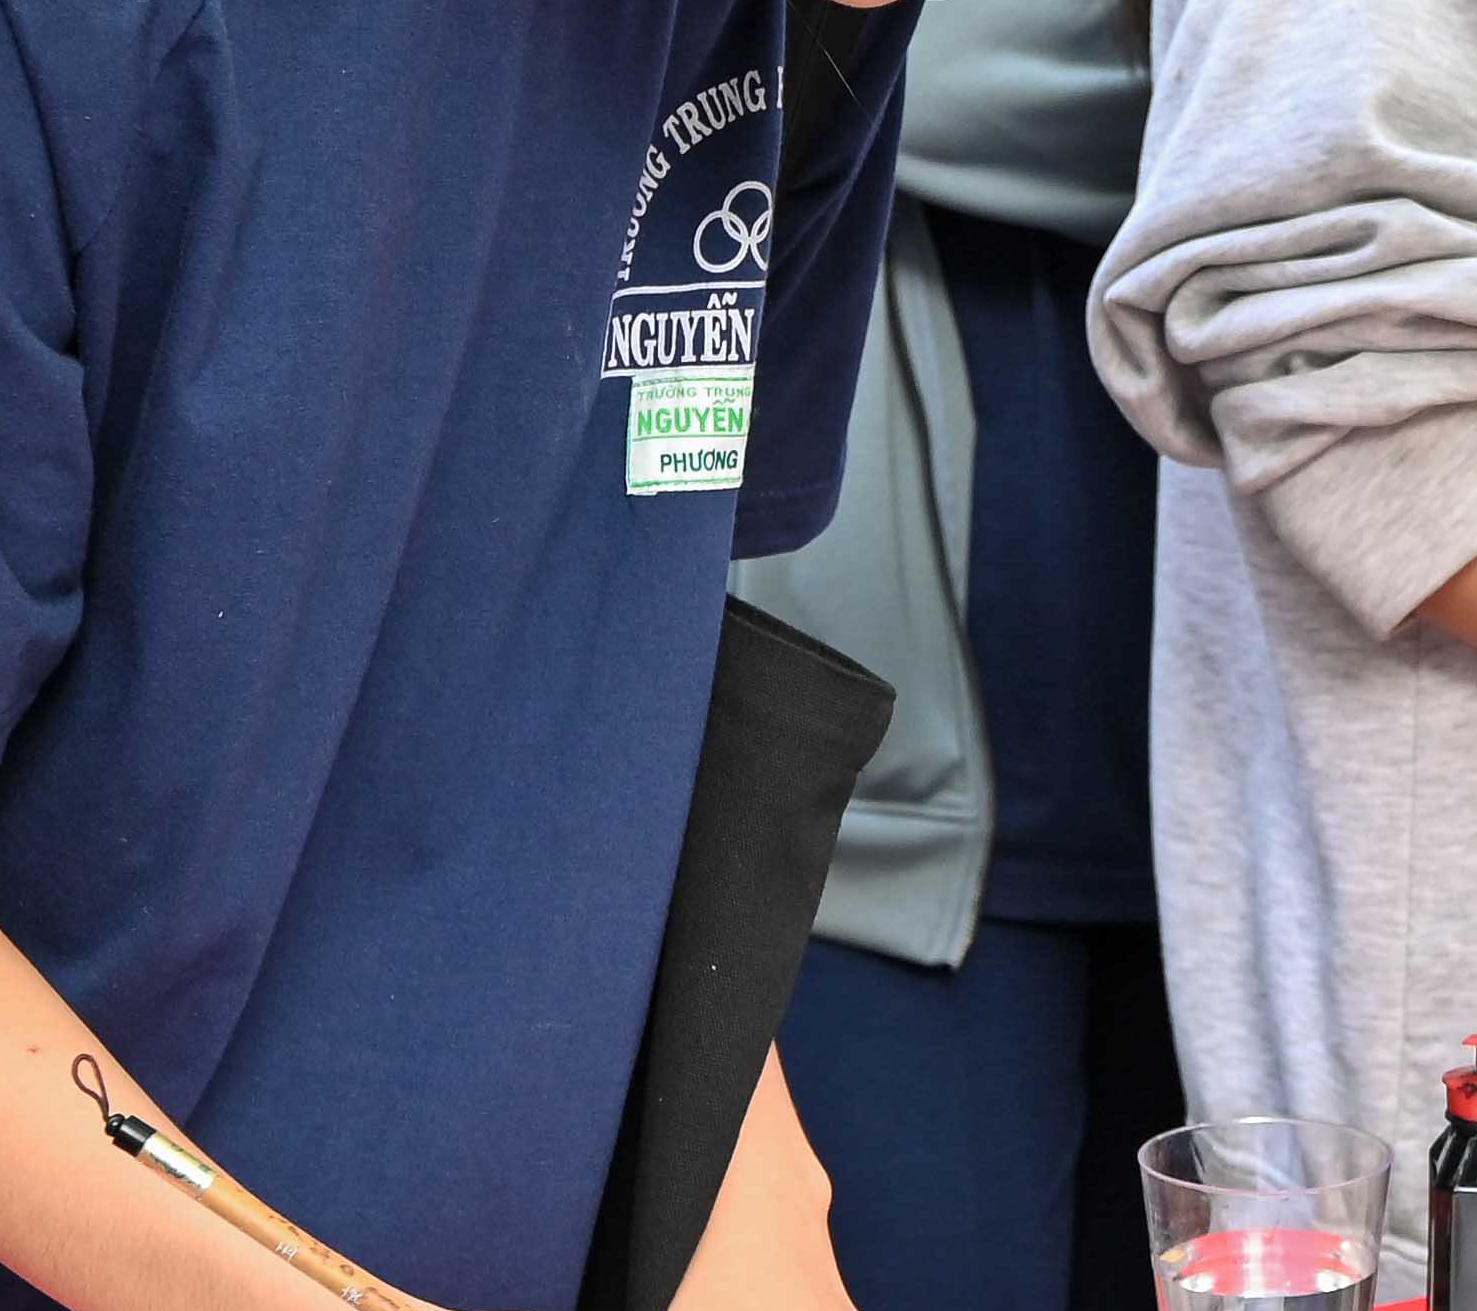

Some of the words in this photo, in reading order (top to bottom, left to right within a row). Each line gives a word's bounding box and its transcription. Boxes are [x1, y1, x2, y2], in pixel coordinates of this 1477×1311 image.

[662, 68, 767, 157] TRUNG
[607, 291, 756, 369] NGUYỄN
[636, 398, 745, 436] NGUYỄN
[659, 448, 740, 474] PHƯƠNG
